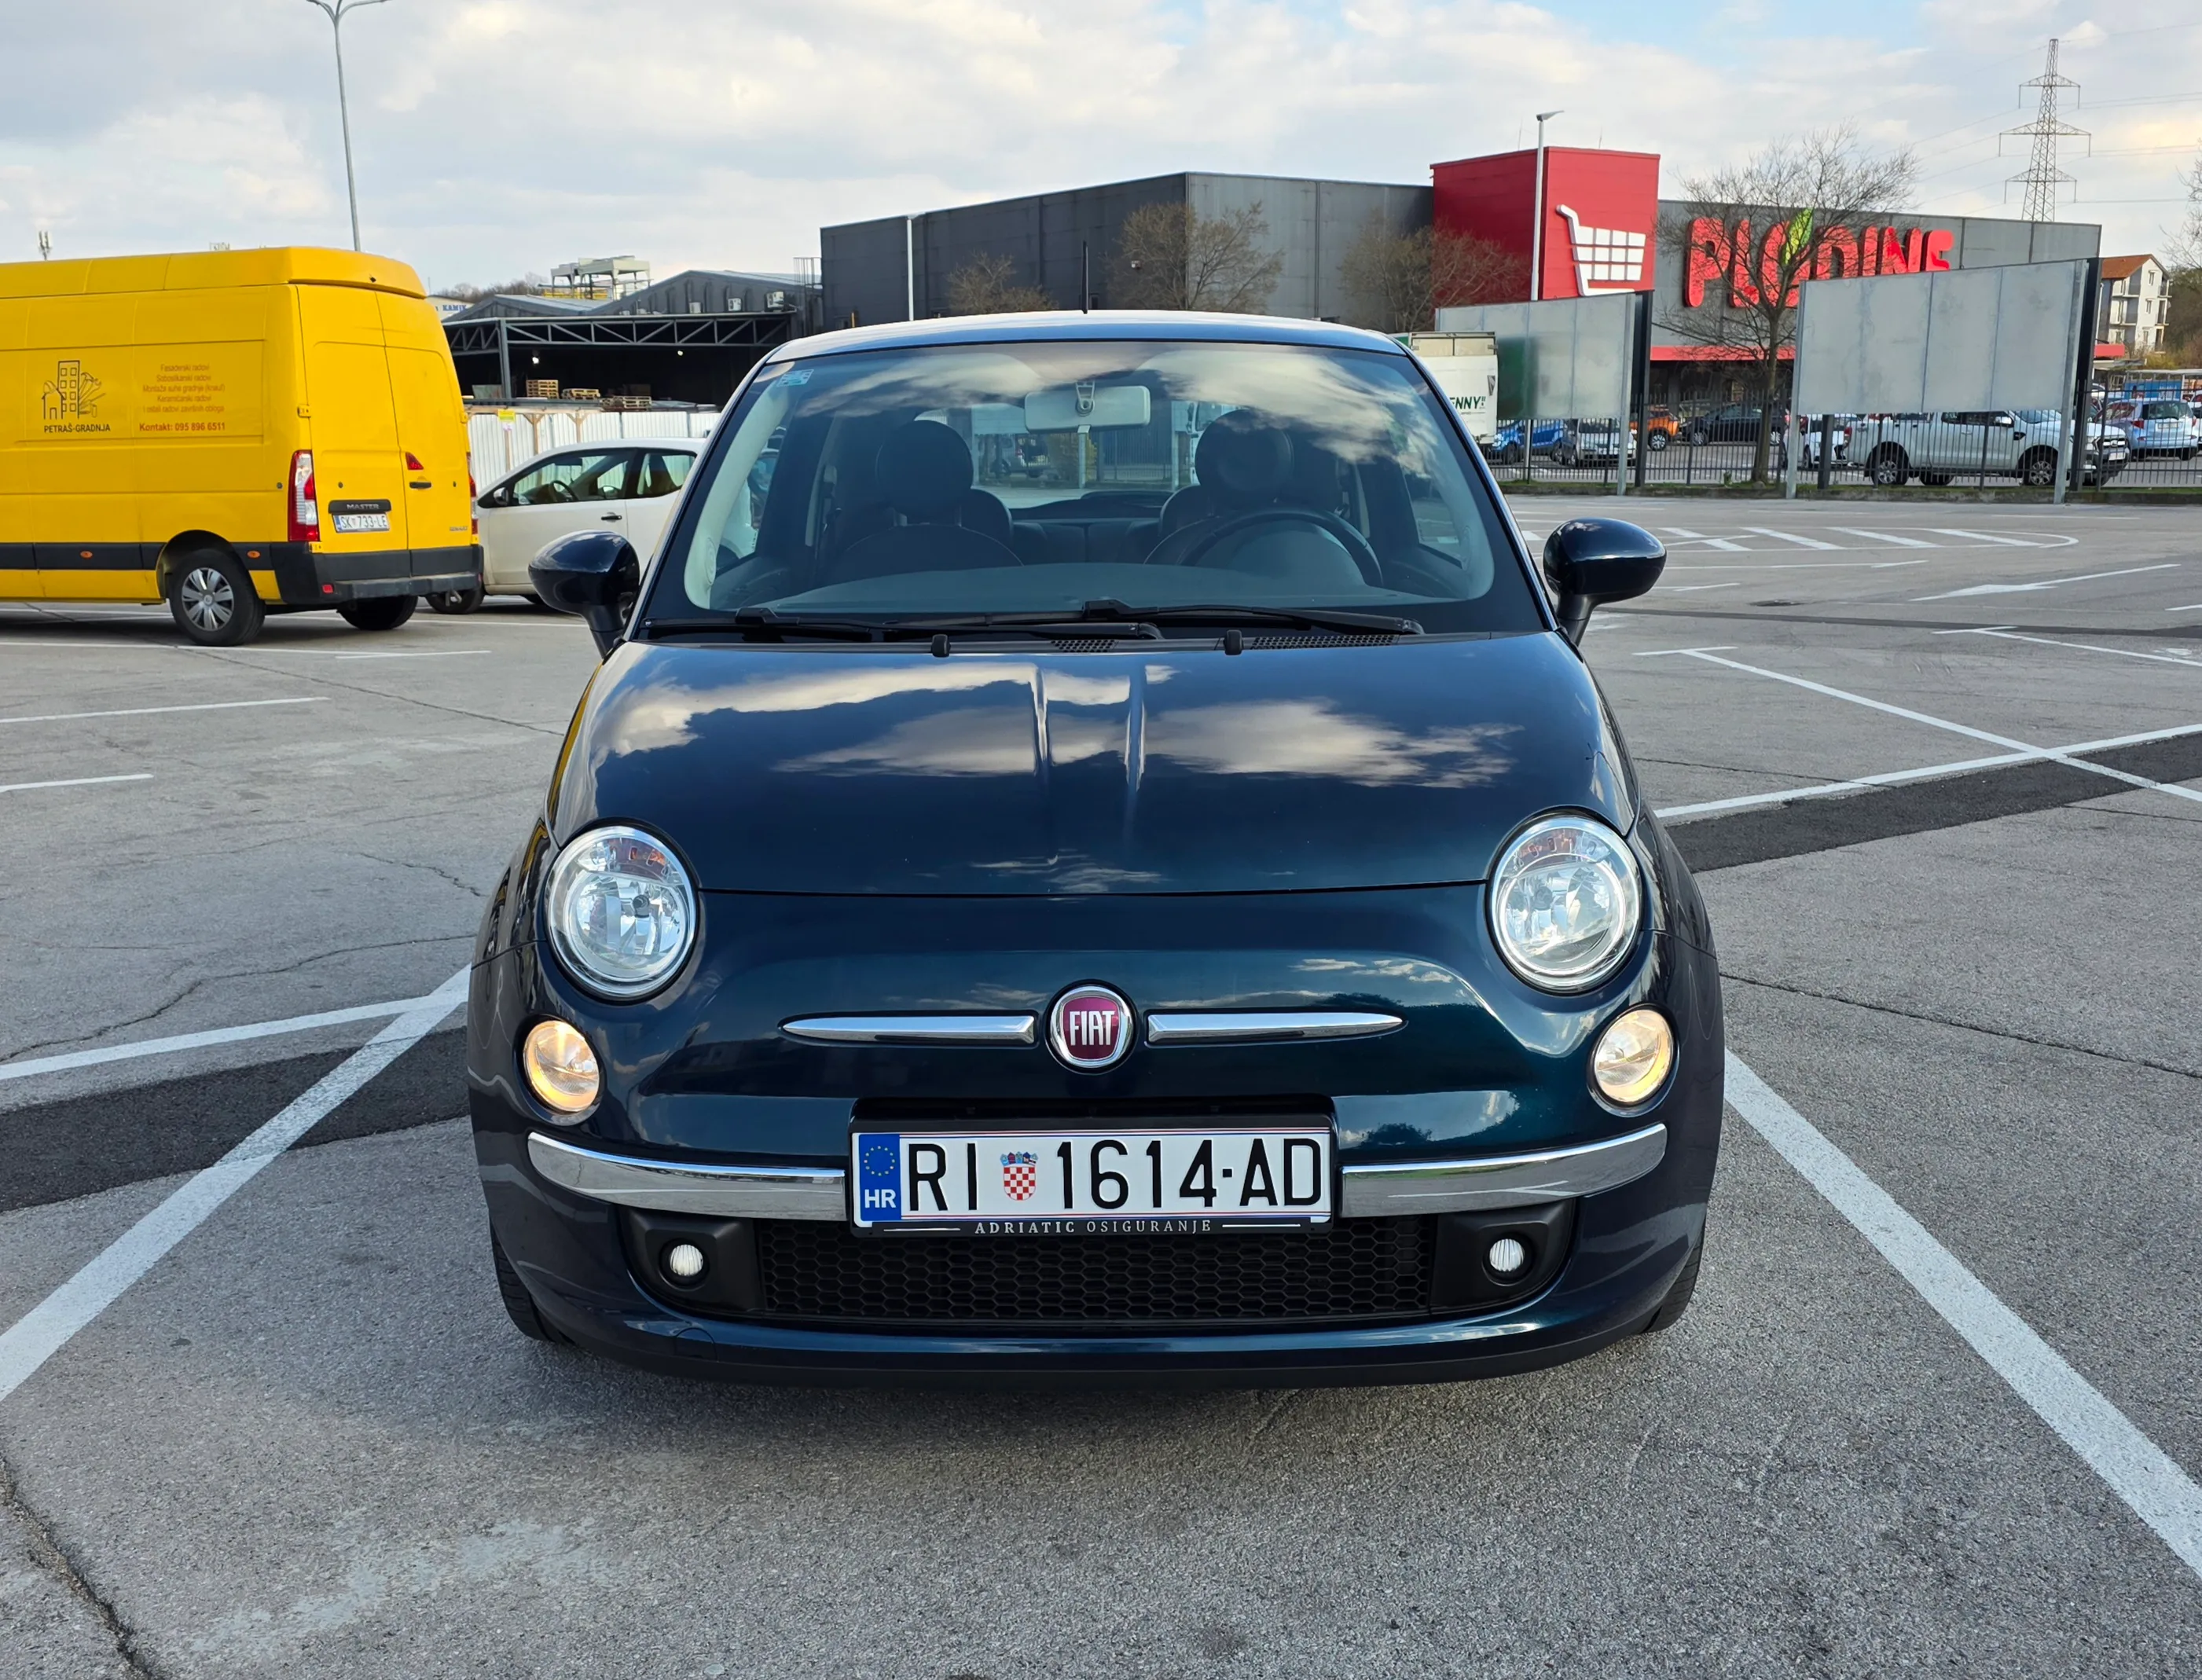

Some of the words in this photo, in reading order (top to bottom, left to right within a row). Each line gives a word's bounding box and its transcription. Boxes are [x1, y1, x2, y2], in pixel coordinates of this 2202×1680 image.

[1686, 217, 1954, 307] PLODINE
[44, 423, 111, 433] PETRAŠ-GRADNJA
[139, 423, 173, 431] Kontakt:
[174, 422, 189, 431] 095
[191, 422, 205, 431] 896
[207, 422, 226, 431] 6511
[341, 515, 353, 528] SK
[1070, 1011, 1115, 1046] FIAT
[908, 1143, 979, 1211] RI
[864, 1189, 897, 1209] HR
[974, 1221, 1075, 1234] ADRIATIC
[1086, 1220, 1211, 1234] OSIGURANJE
